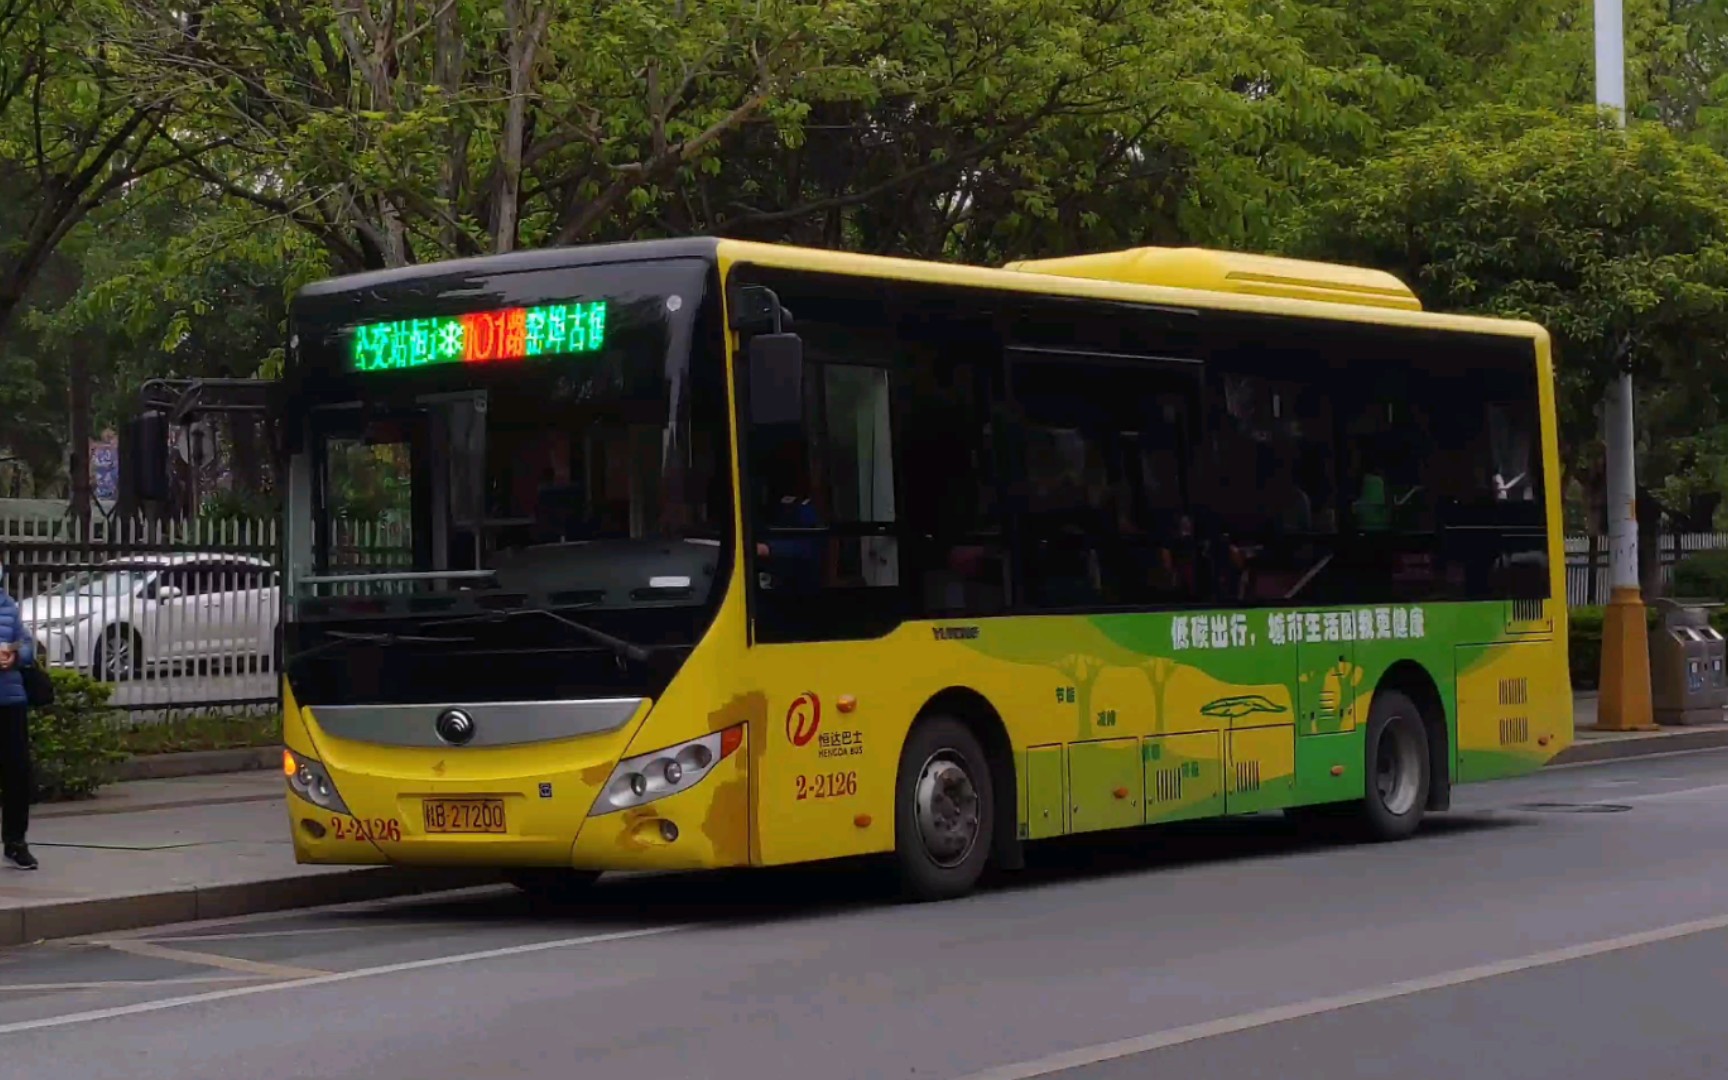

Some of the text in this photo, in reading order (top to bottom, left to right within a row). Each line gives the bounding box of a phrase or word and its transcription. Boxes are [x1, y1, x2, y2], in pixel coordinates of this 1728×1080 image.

[818, 730, 863, 747] 恒达巴士
[818, 746, 863, 758] HENGDA BUS
[796, 771, 857, 800] 2-2126
[331, 816, 401, 841] 2-2126
